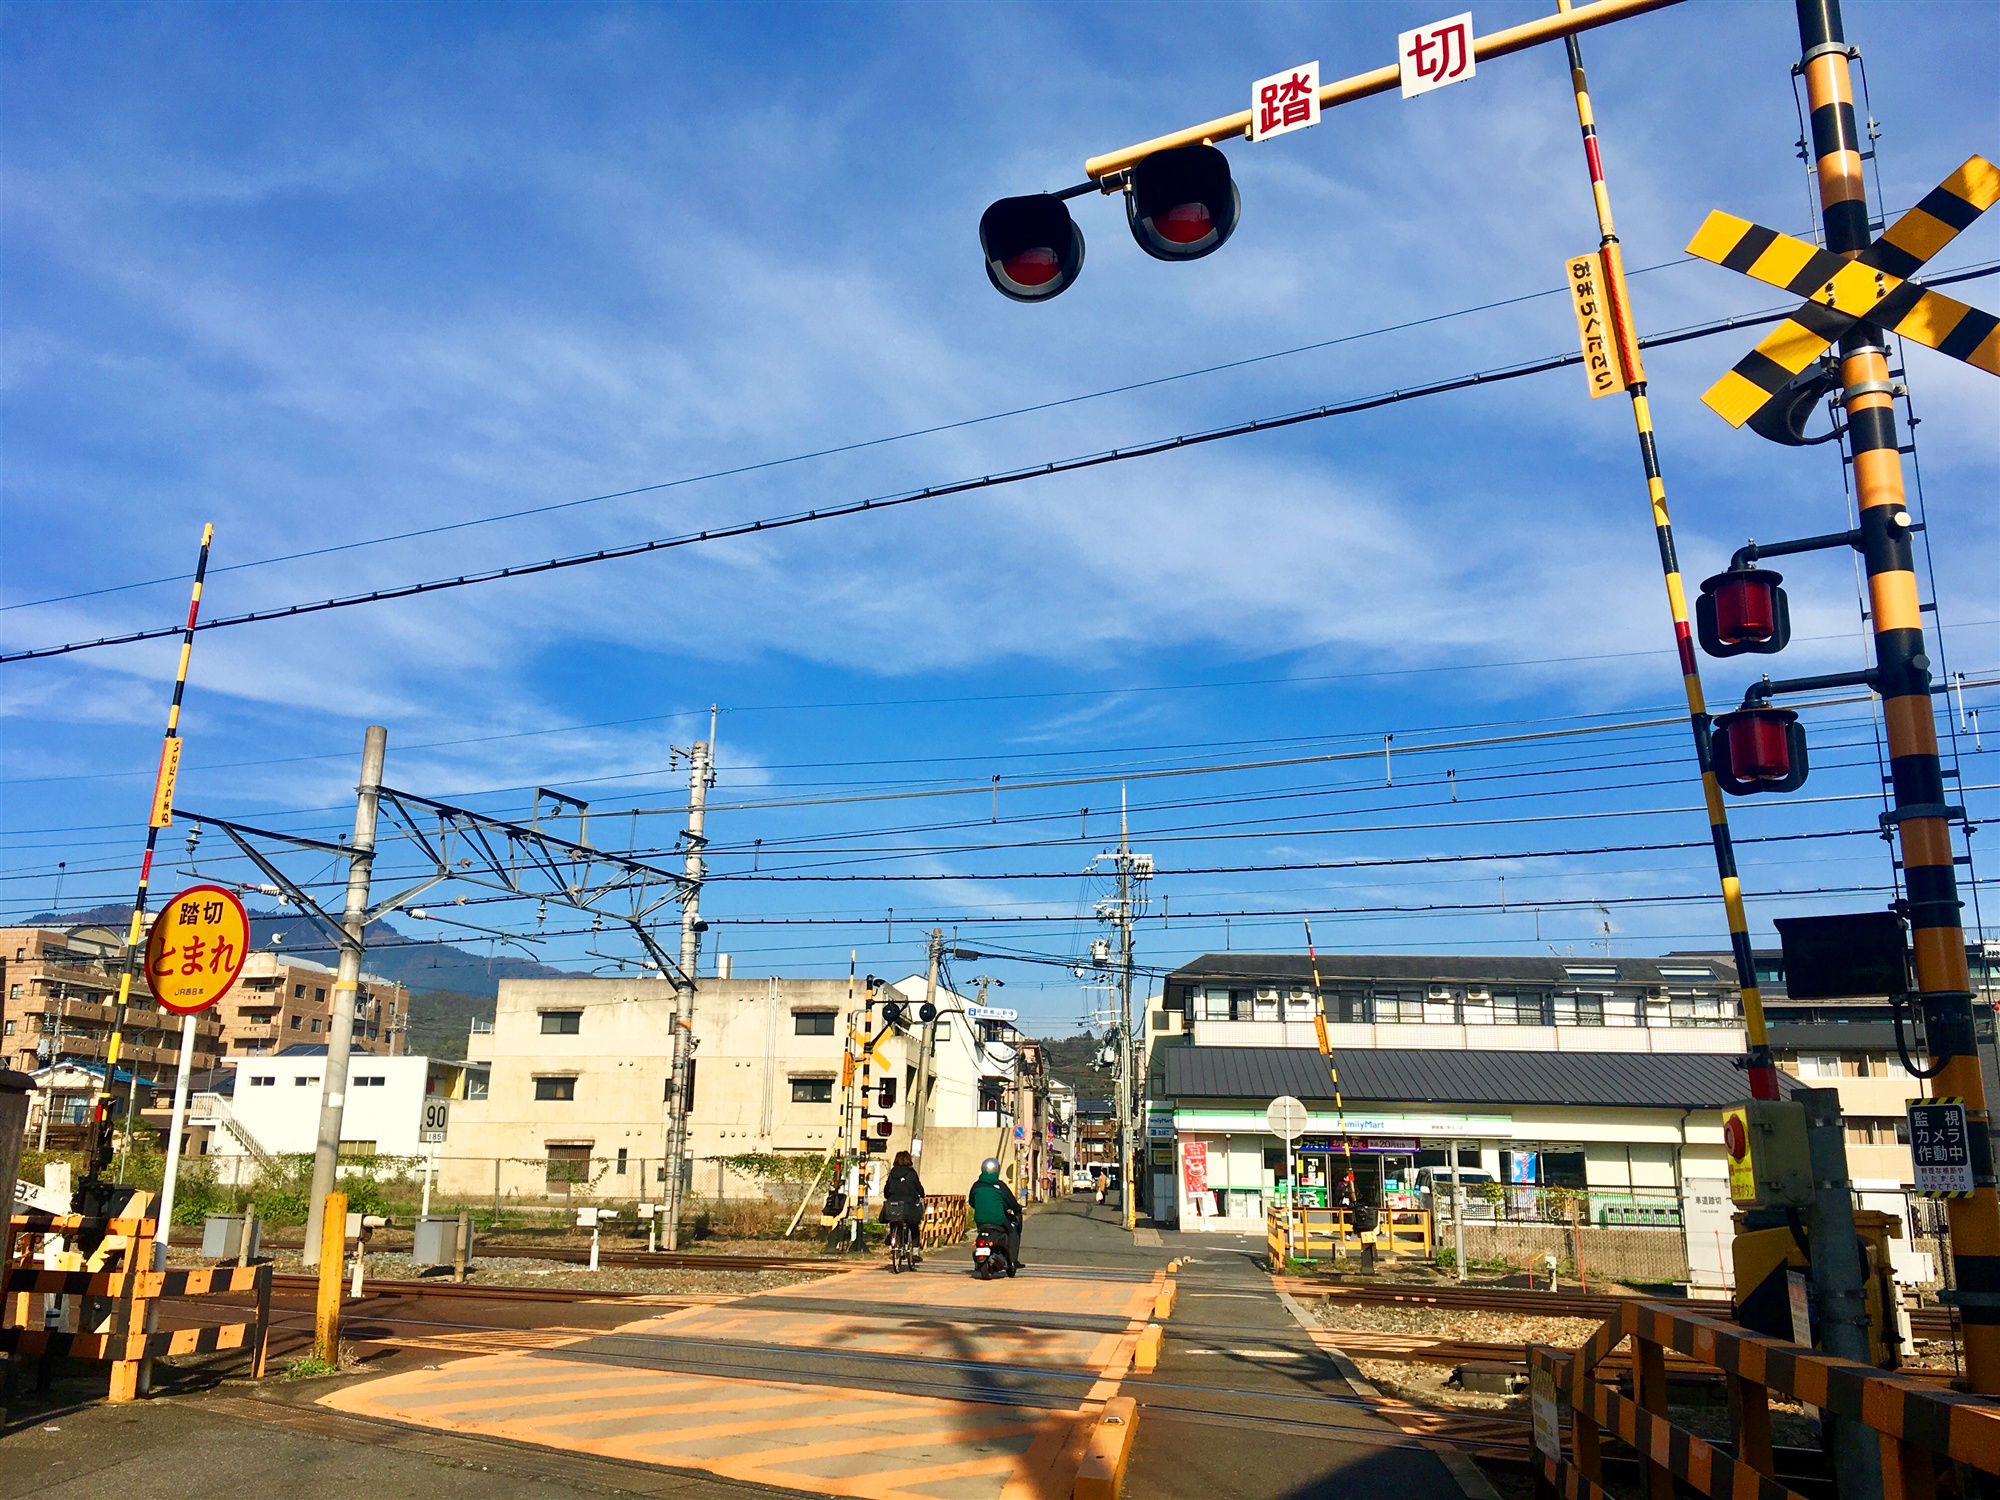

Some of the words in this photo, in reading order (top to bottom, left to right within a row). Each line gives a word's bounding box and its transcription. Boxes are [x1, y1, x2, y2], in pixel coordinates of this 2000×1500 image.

[1407, 23, 1467, 82] 切
[1260, 73, 1312, 134] 踏
[161, 742, 179, 823] おまちください
[179, 901, 224, 926] 踏切
[151, 934, 236, 977] とまれ
[174, 988, 204, 997] JR西日本
[426, 1105, 446, 1128] 90
[1916, 1128, 1960, 1143] カメラ
[1918, 1145, 1963, 1161] 作動中
